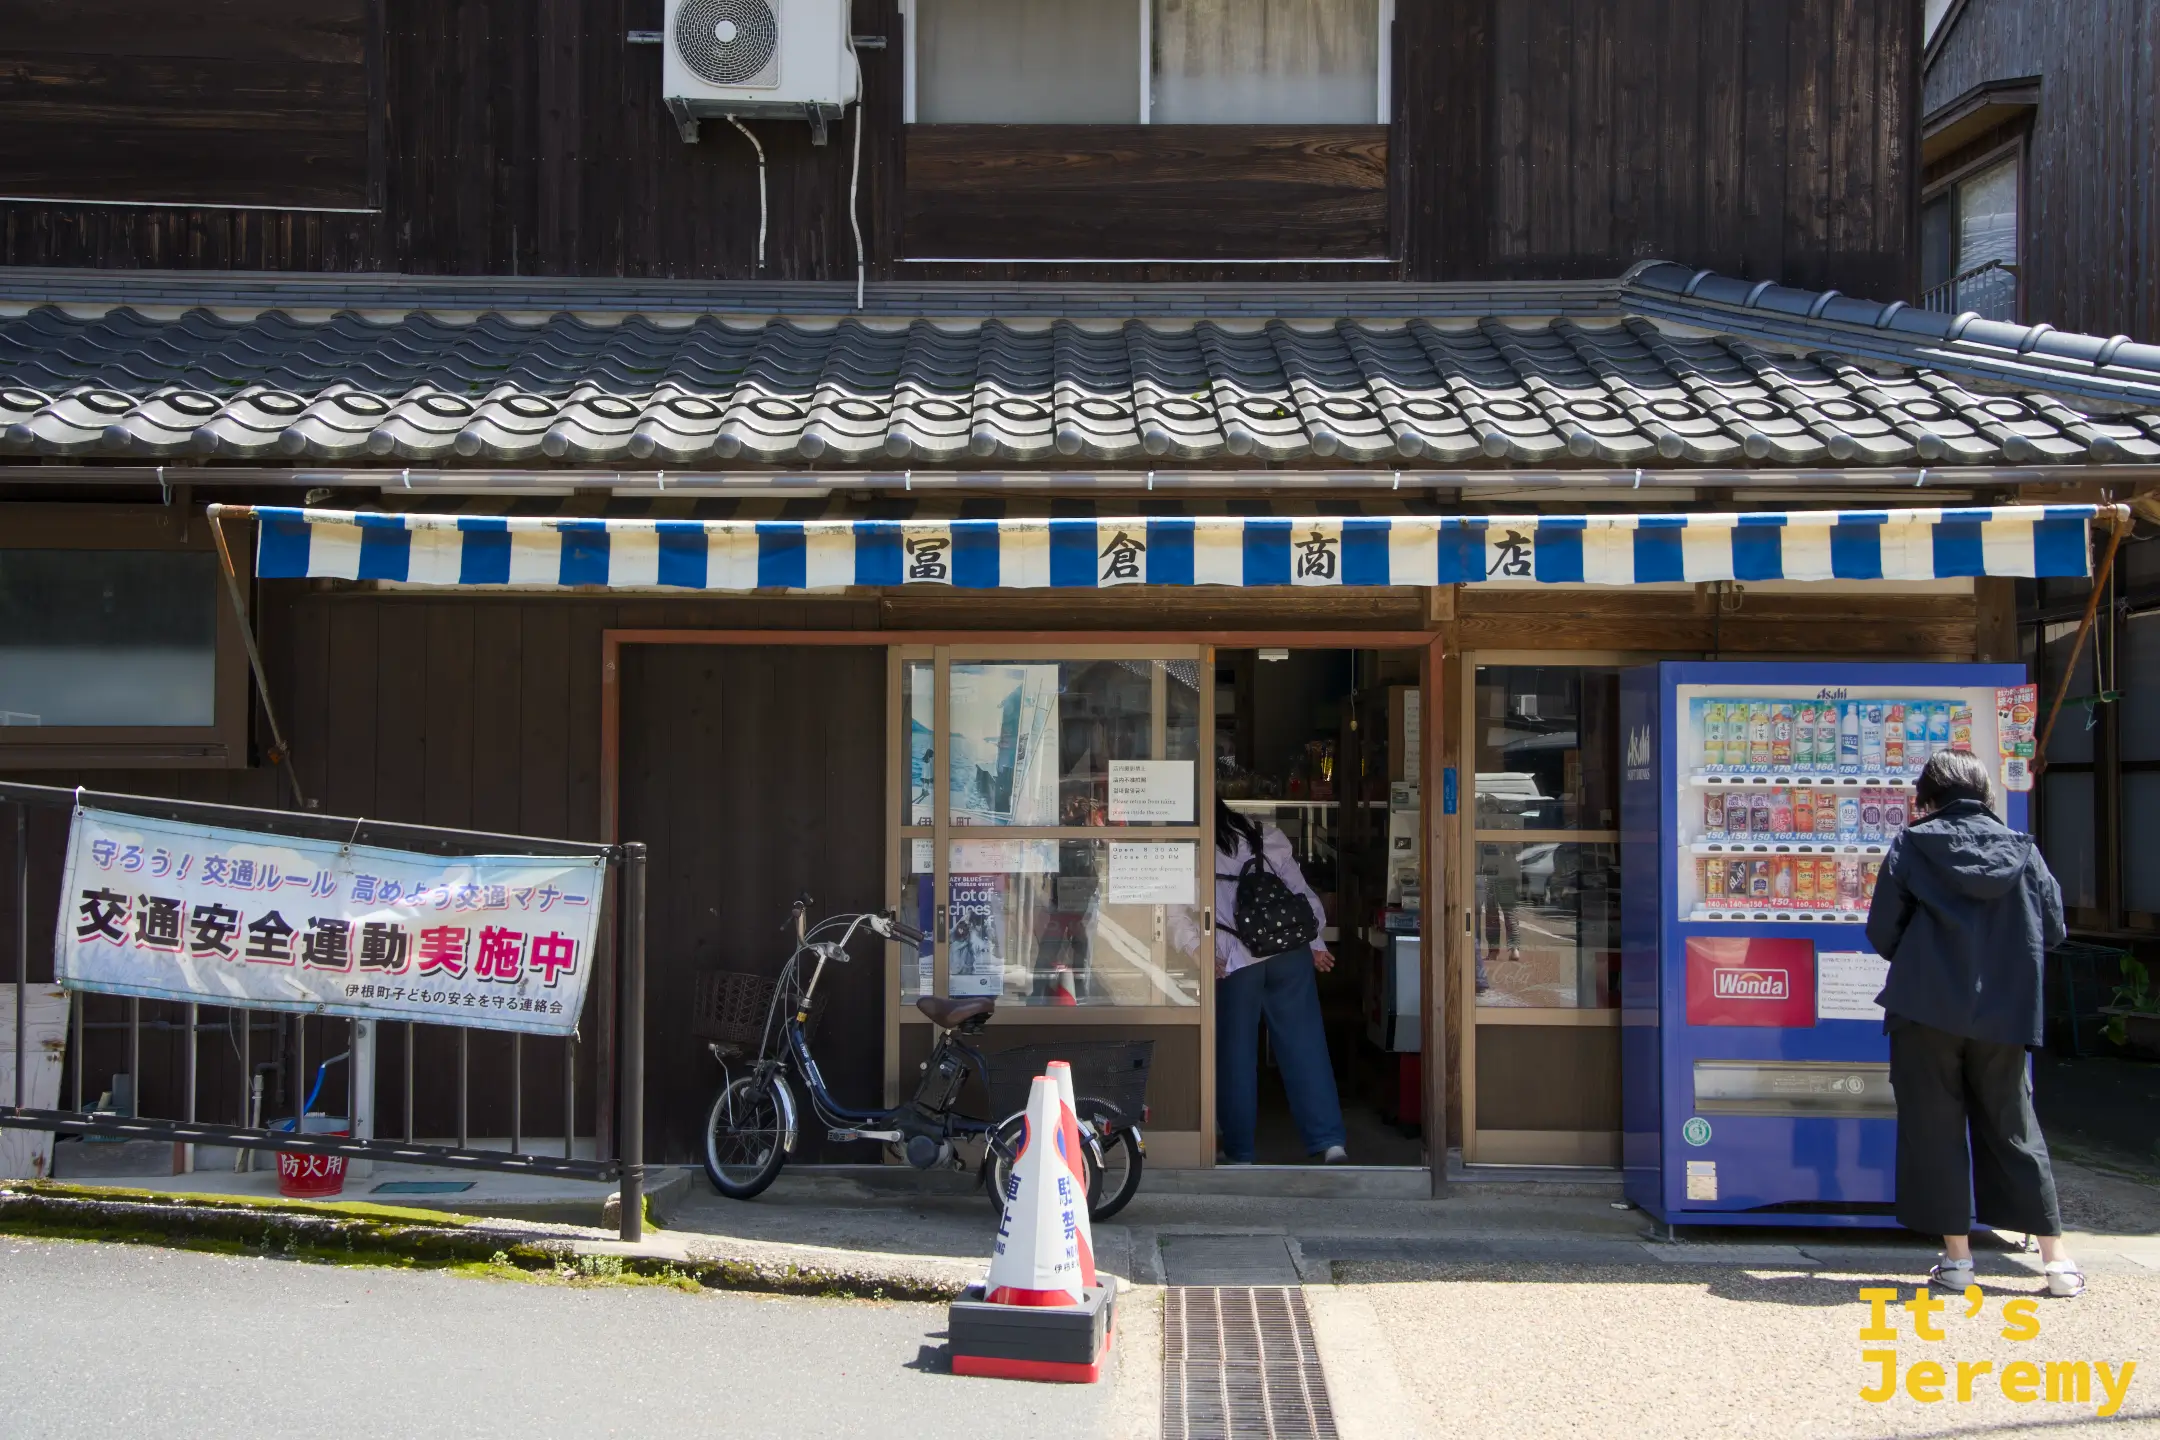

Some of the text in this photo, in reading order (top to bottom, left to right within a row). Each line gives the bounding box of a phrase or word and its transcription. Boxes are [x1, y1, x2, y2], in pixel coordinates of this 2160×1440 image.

[1817, 687, 1848, 700] Asahi
[1627, 724, 1650, 766] Asahi
[1728, 860, 1746, 891] BLACK
[352, 874, 588, 913] 高めよう交通マナー
[953, 887, 995, 902] Lot of
[949, 901, 991, 915] choes
[77, 887, 578, 984] 交通安全運動実施中
[1719, 973, 1783, 995] Wonda
[346, 984, 563, 1014] 伊根町子どもの安全を守る連絡会
[281, 1153, 342, 1178] 防火用
